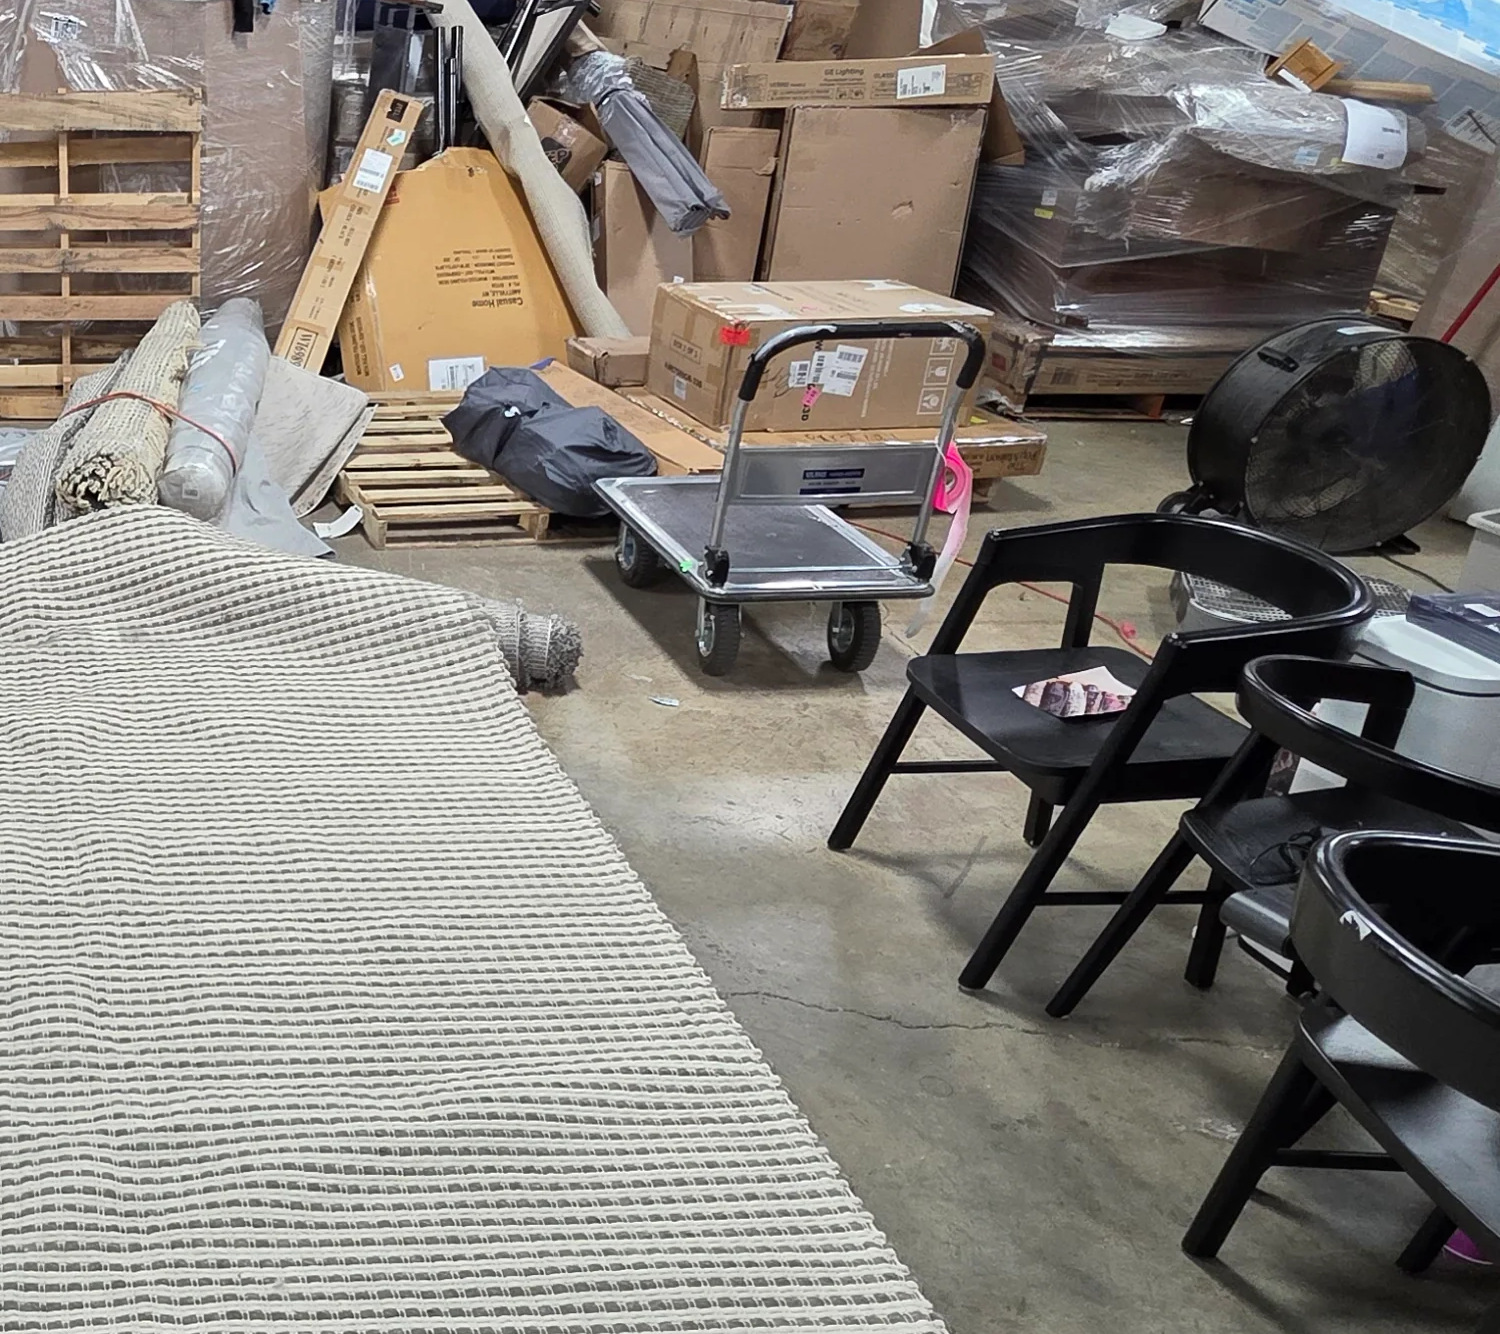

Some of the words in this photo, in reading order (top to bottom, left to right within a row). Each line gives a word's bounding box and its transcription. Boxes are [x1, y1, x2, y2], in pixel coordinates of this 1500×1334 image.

[835, 68, 864, 76] Lighting
[472, 298, 495, 307] Home
[496, 296, 523, 307] Casual
